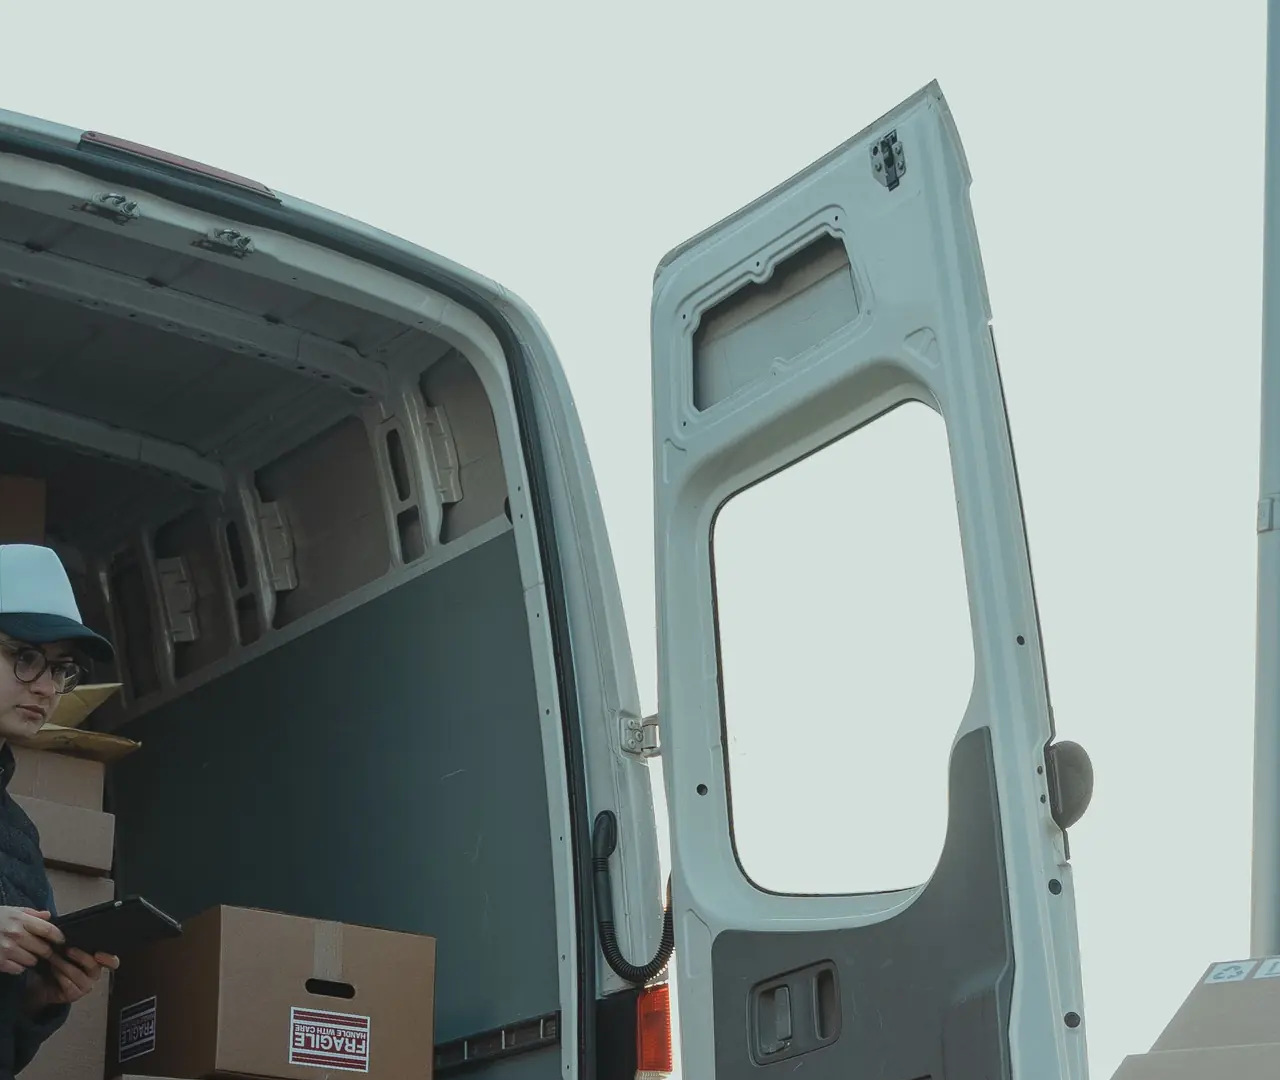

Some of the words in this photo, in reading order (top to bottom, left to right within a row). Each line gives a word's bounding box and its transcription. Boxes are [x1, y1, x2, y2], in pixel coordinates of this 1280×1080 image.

[121, 1020, 154, 1045] FRAGILE
[294, 1024, 316, 1033] CARE
[316, 1027, 335, 1036] WITH
[337, 1030, 366, 1040] HANDLE
[294, 1032, 366, 1054] FRAGILE
